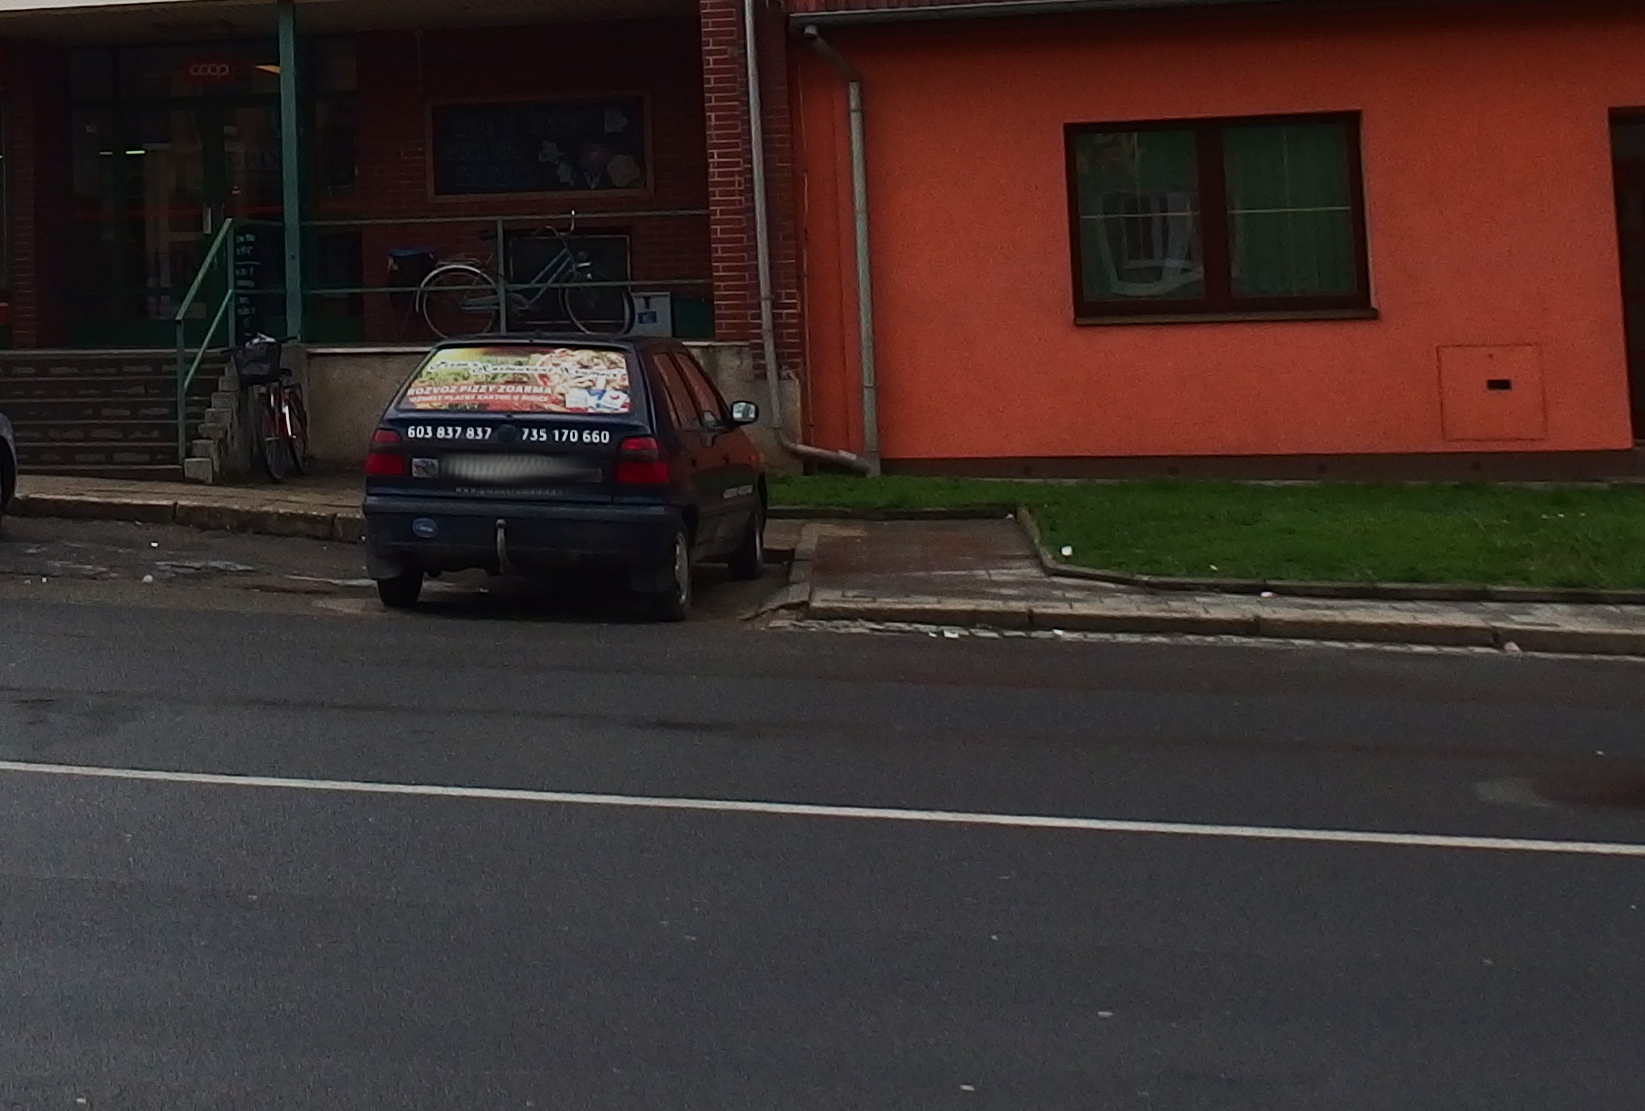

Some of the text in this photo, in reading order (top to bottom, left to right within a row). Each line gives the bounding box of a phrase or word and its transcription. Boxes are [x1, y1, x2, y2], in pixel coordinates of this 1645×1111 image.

[407, 425, 492, 439] 603 837 837
[521, 427, 610, 444] 735 170 660
